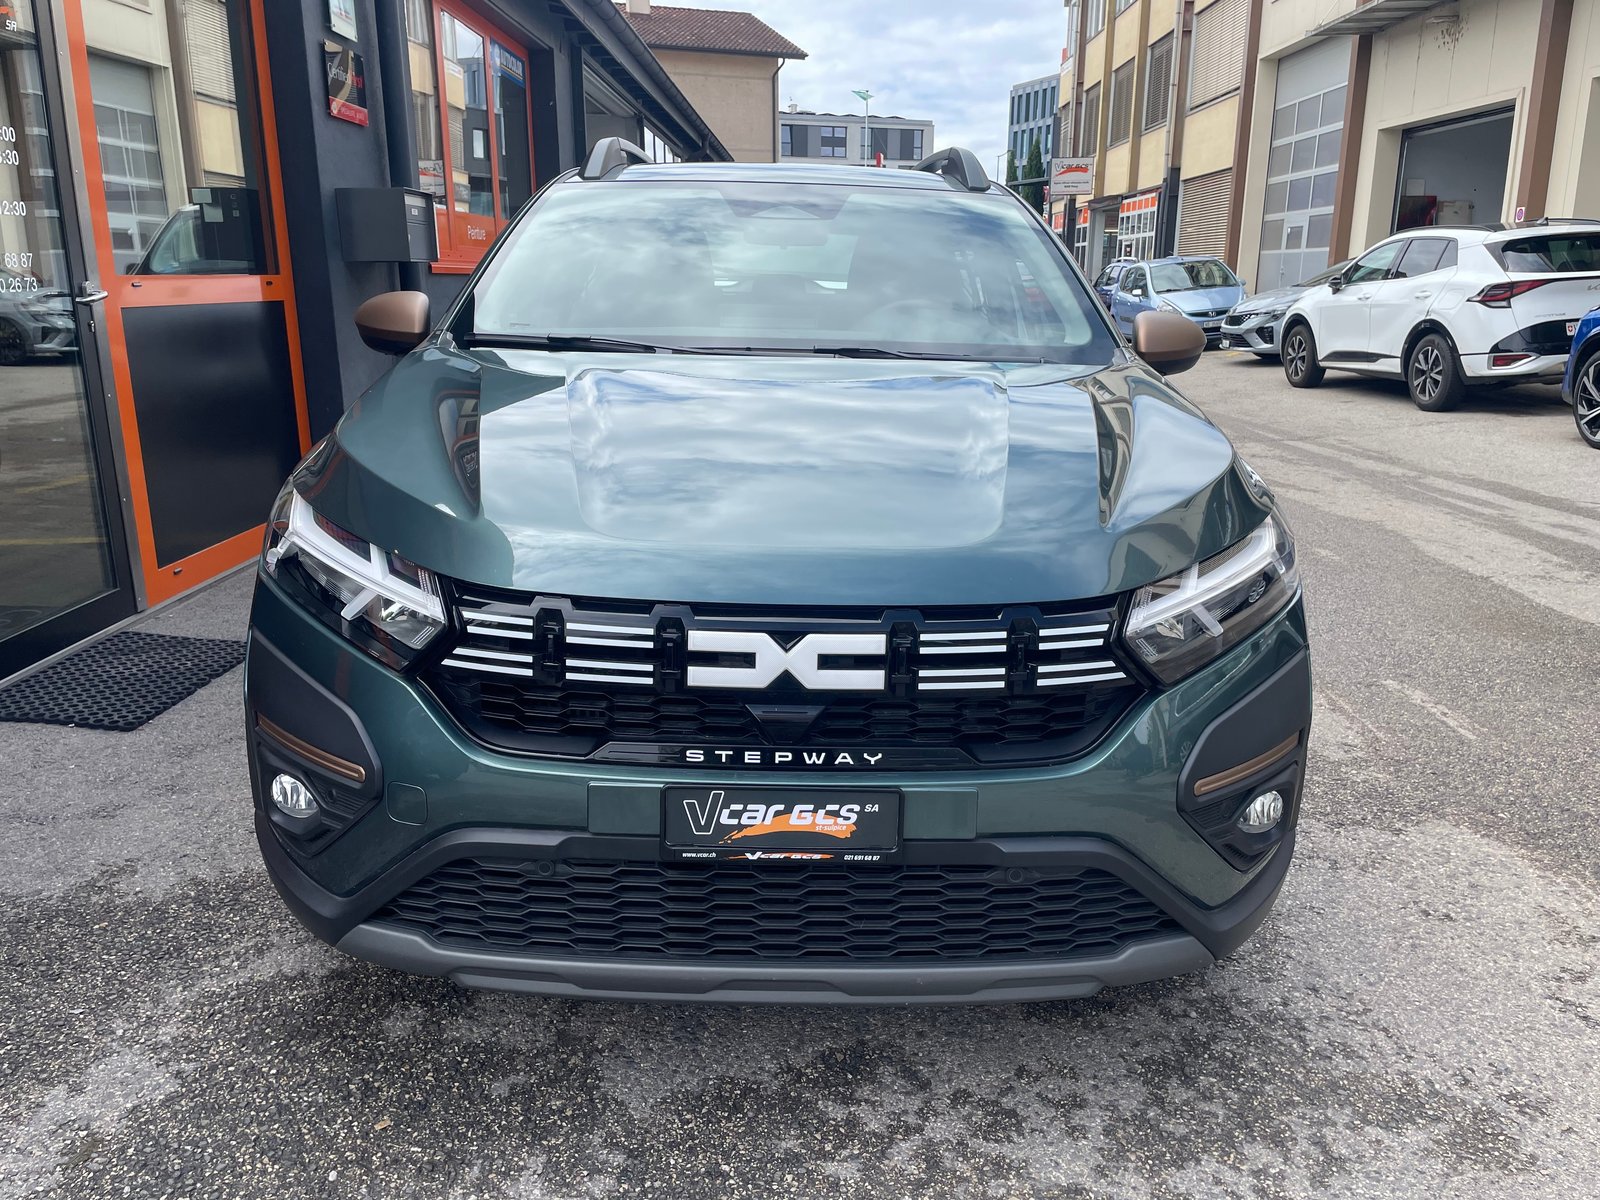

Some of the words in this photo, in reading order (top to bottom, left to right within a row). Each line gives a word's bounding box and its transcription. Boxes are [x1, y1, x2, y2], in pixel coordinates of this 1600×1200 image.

[5, 252, 18, 268] 68
[20, 252, 33, 268] 87
[9, 277, 23, 293] 26
[24, 277, 38, 292] 73
[686, 750, 882, 765] STEPWAY
[864, 803, 879, 813] SA
[815, 824, 847, 832] st-sulpice
